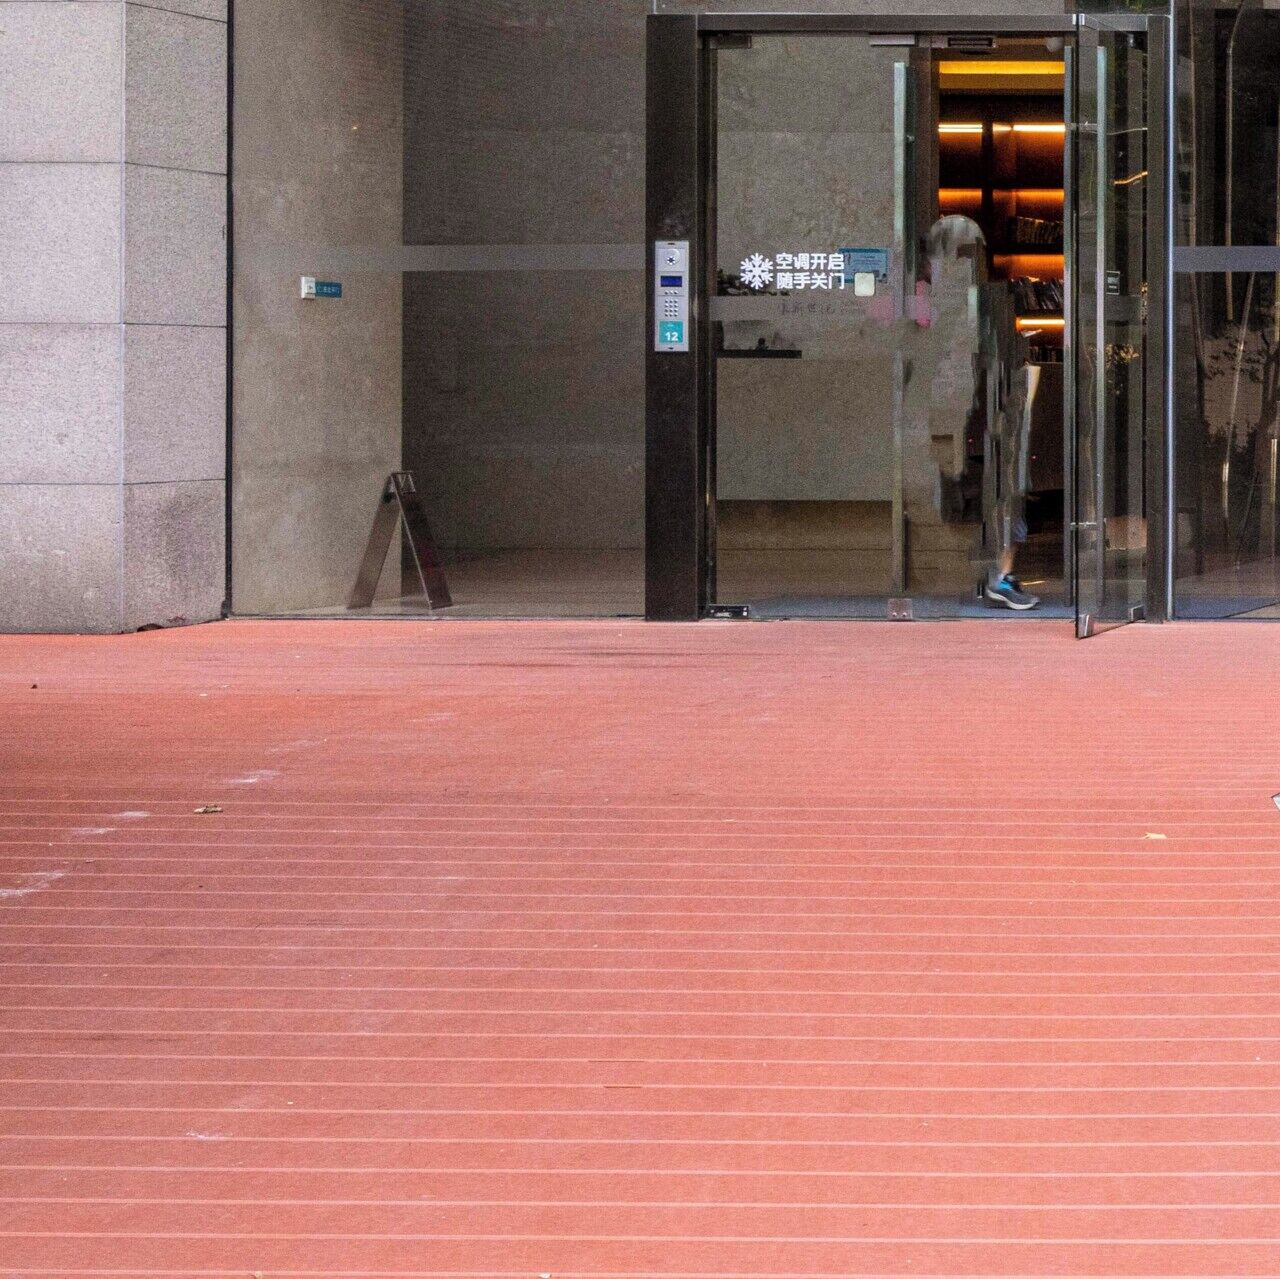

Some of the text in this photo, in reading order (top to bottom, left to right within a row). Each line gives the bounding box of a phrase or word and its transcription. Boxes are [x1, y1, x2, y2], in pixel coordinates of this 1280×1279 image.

[776, 252, 845, 270] 空调开启
[776, 272, 845, 290] 随手关门
[665, 331, 679, 341] 12
